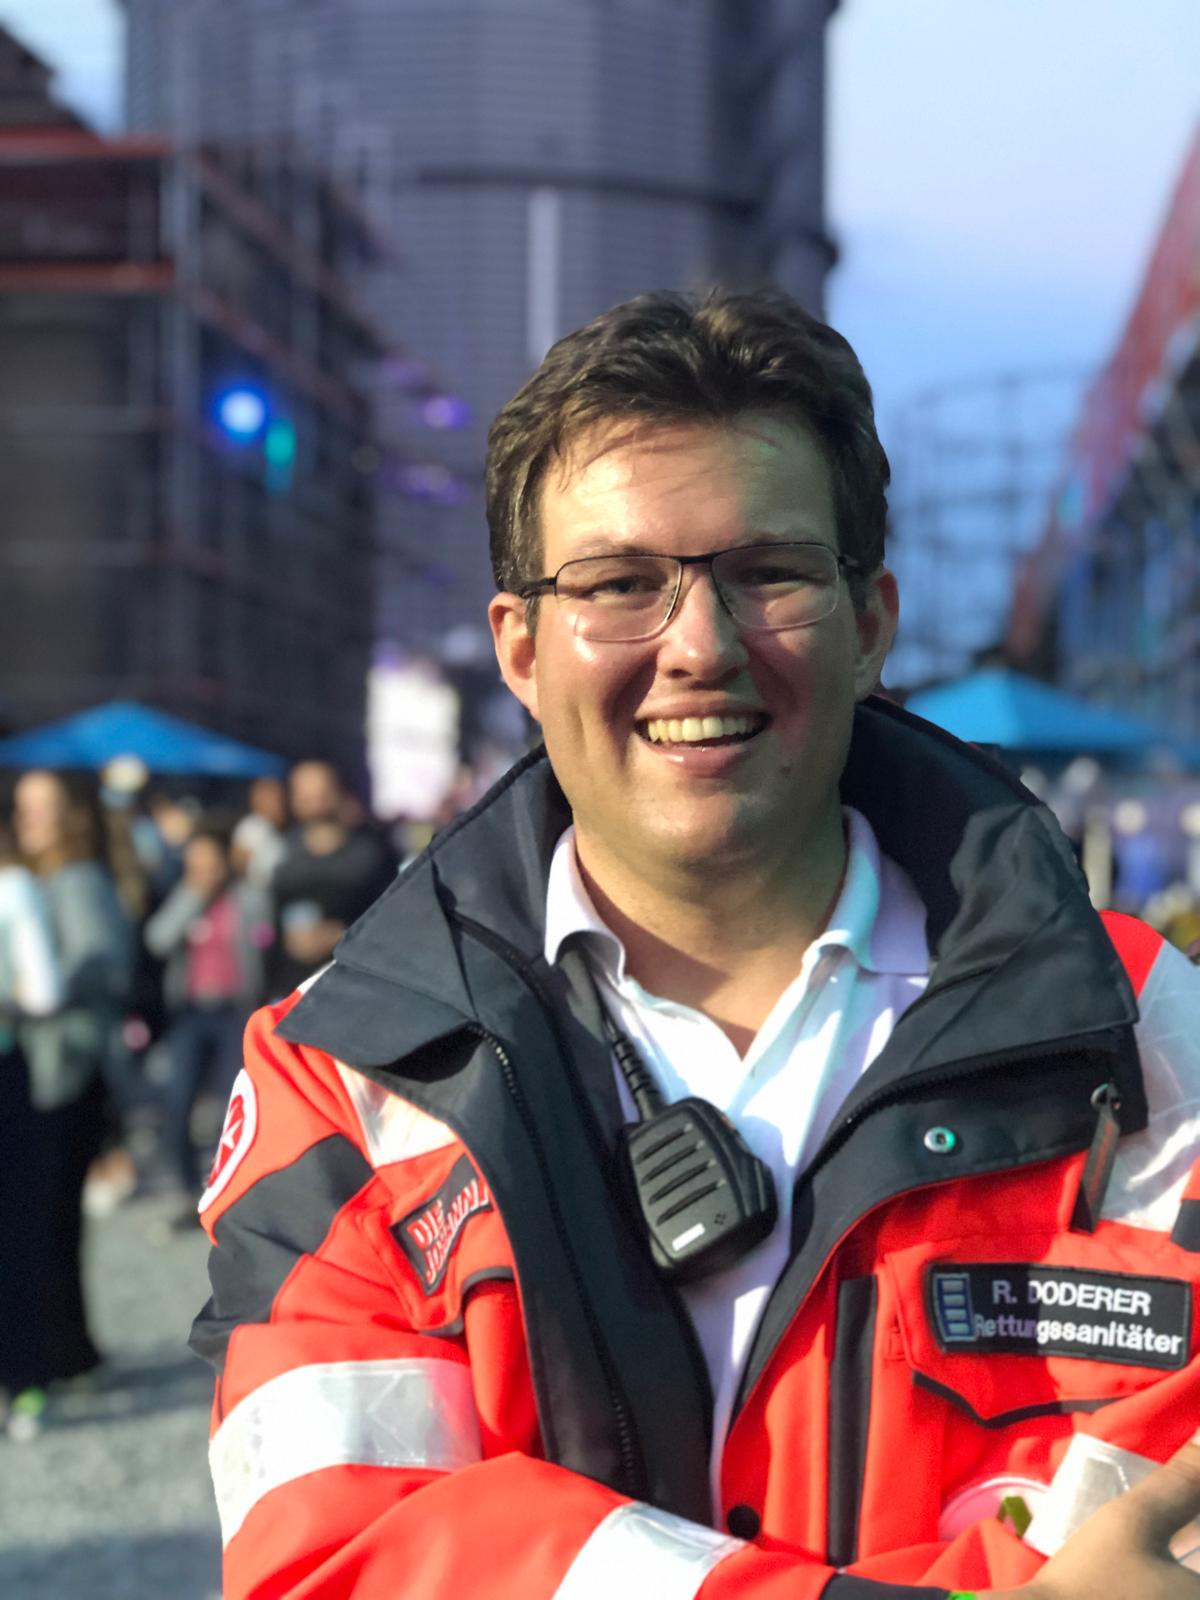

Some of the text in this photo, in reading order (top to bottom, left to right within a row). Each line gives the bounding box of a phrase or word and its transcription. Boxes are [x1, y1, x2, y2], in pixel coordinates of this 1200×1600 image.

[992, 1279, 1151, 1316] R. DODERER
[973, 1312, 1183, 1356] Rettungssanitäter
